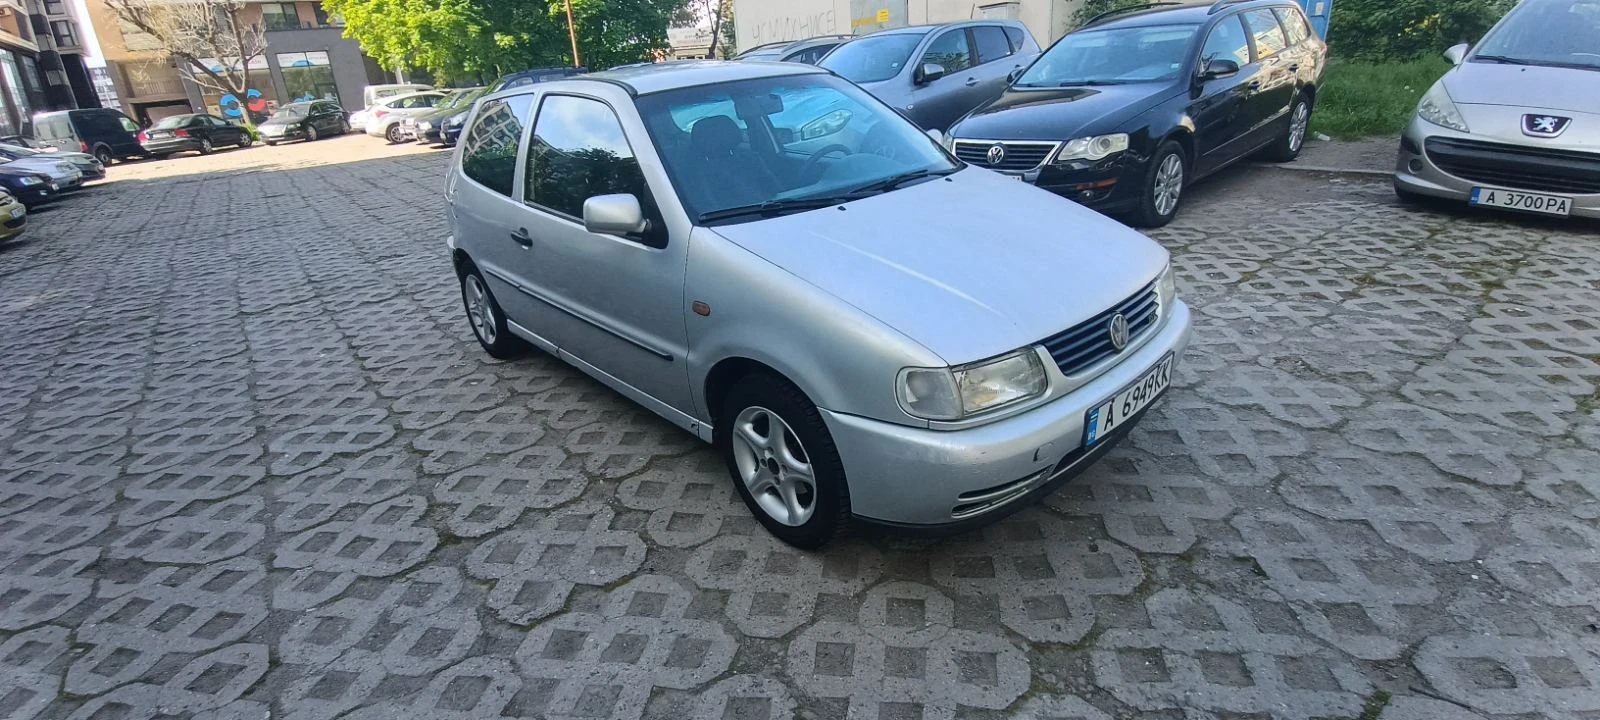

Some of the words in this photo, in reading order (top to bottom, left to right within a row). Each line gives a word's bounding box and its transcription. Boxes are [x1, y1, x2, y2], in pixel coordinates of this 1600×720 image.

[1486, 191, 1496, 204] A
[1103, 400, 1115, 432] A
[1122, 360, 1170, 417] 6949KK
